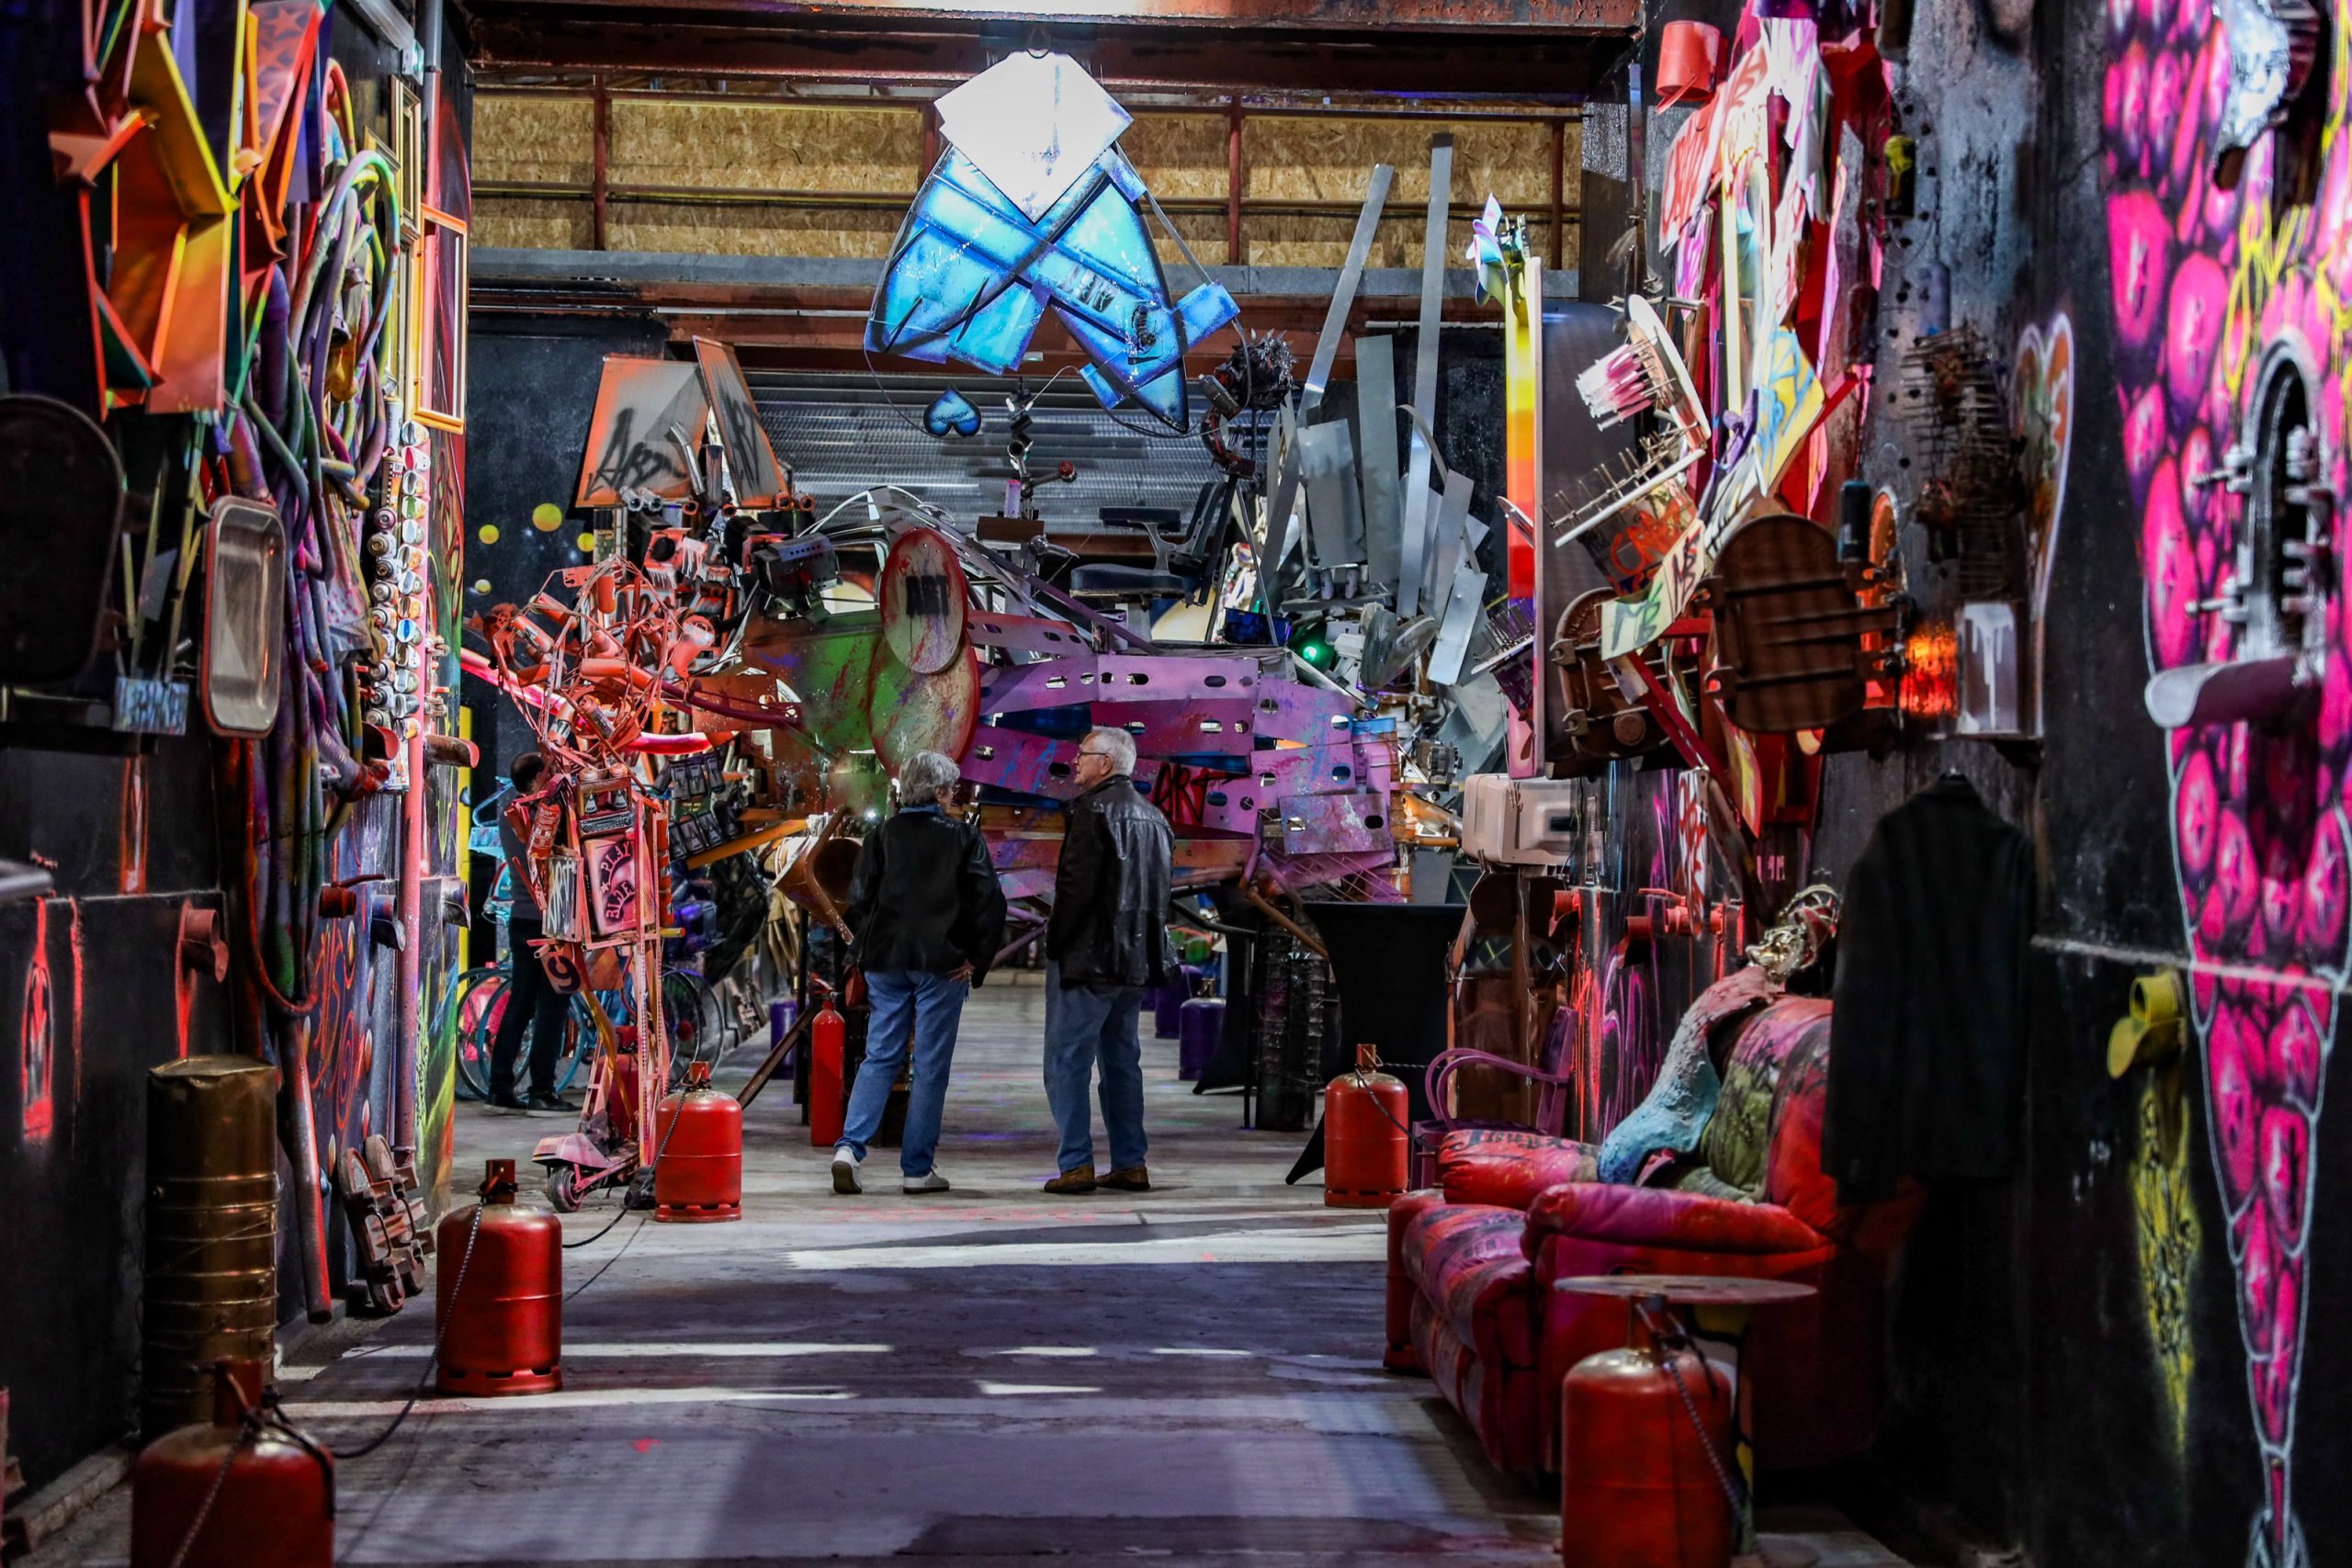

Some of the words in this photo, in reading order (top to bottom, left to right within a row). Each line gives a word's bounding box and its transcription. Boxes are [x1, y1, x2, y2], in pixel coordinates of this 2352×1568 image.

[905, 574, 949, 617] ART
[1152, 761, 1252, 823] ART
[547, 954, 582, 992] 9
